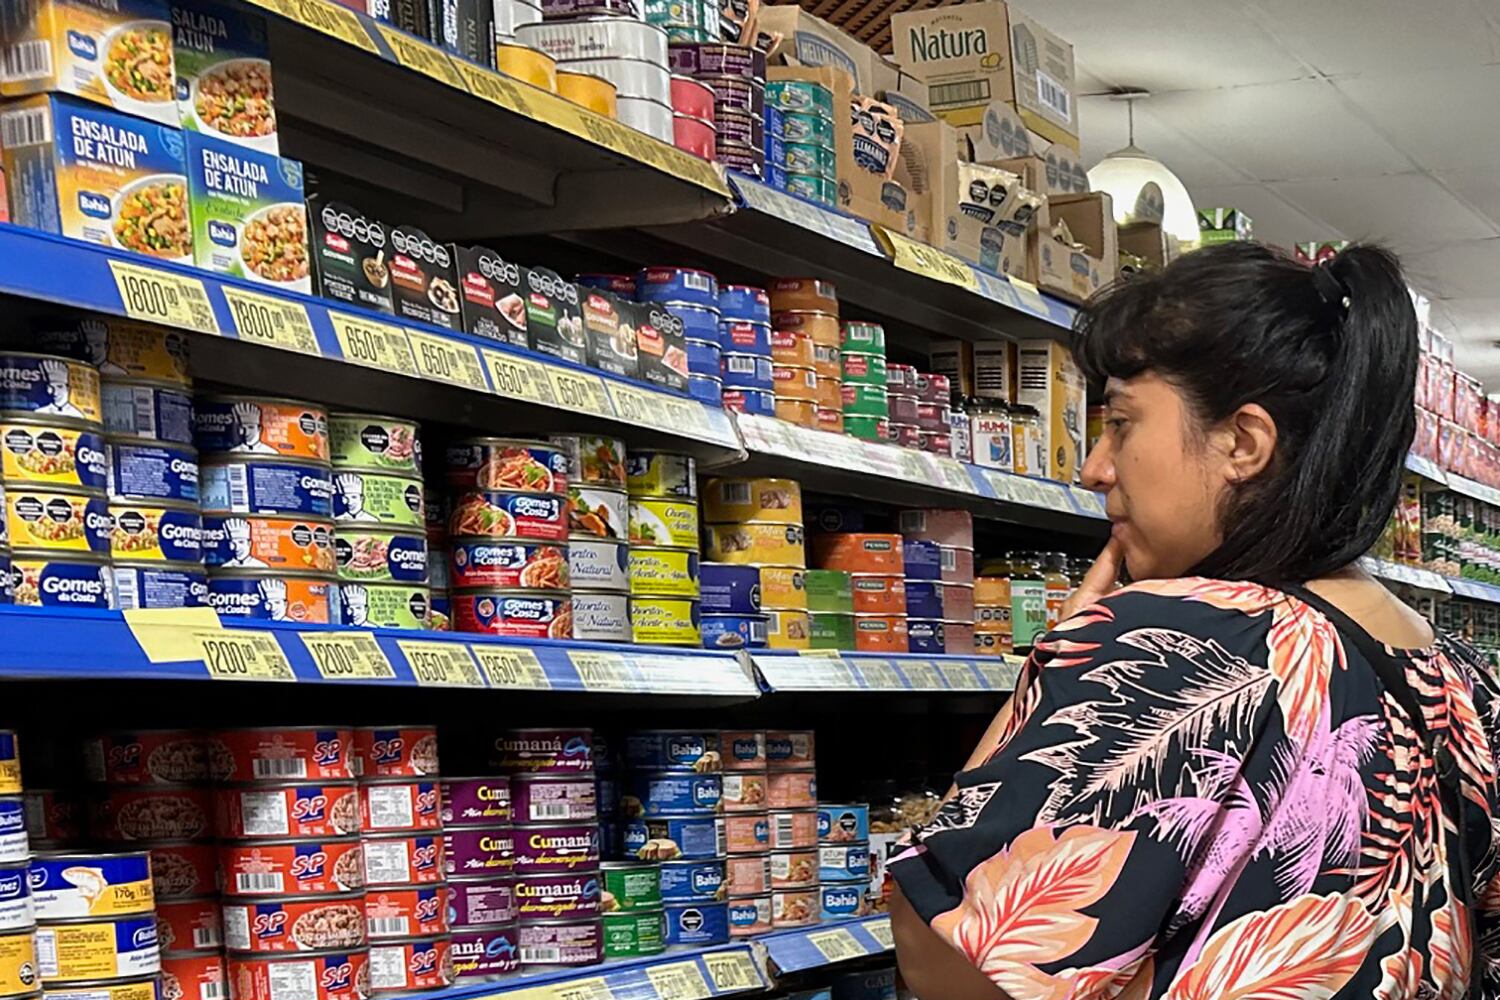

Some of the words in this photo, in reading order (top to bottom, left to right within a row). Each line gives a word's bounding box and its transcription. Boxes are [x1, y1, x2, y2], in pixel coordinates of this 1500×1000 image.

[909, 28, 987, 63] Natura
[71, 116, 148, 155] ENSALADA
[74, 137, 97, 158] DE
[202, 149, 269, 184] ENSALADA
[204, 172, 221, 191] DE
[516, 497, 551, 510] Gomes
[525, 506, 549, 518] Costa
[474, 547, 514, 559] Gomes
[483, 555, 510, 566] Costa
[43, 576, 102, 594] Gomes
[72, 592, 97, 603] Costa
[207, 591, 261, 607] Gomes
[504, 599, 543, 613] Gomes
[225, 605, 251, 615] Costa
[515, 608, 540, 619] Costa
[313, 739, 342, 762] SP
[370, 738, 405, 761] SP
[291, 796, 328, 819] SP
[415, 790, 436, 813] SP
[530, 831, 592, 850] Cumaná
[290, 852, 328, 878] SP
[412, 846, 437, 868] SP
[515, 880, 582, 898] Cumaná
[414, 898, 439, 920] SP
[825, 893, 859, 907] Bahía
[252, 911, 288, 935] SP
[410, 949, 437, 971] SP
[319, 963, 353, 988] SP
